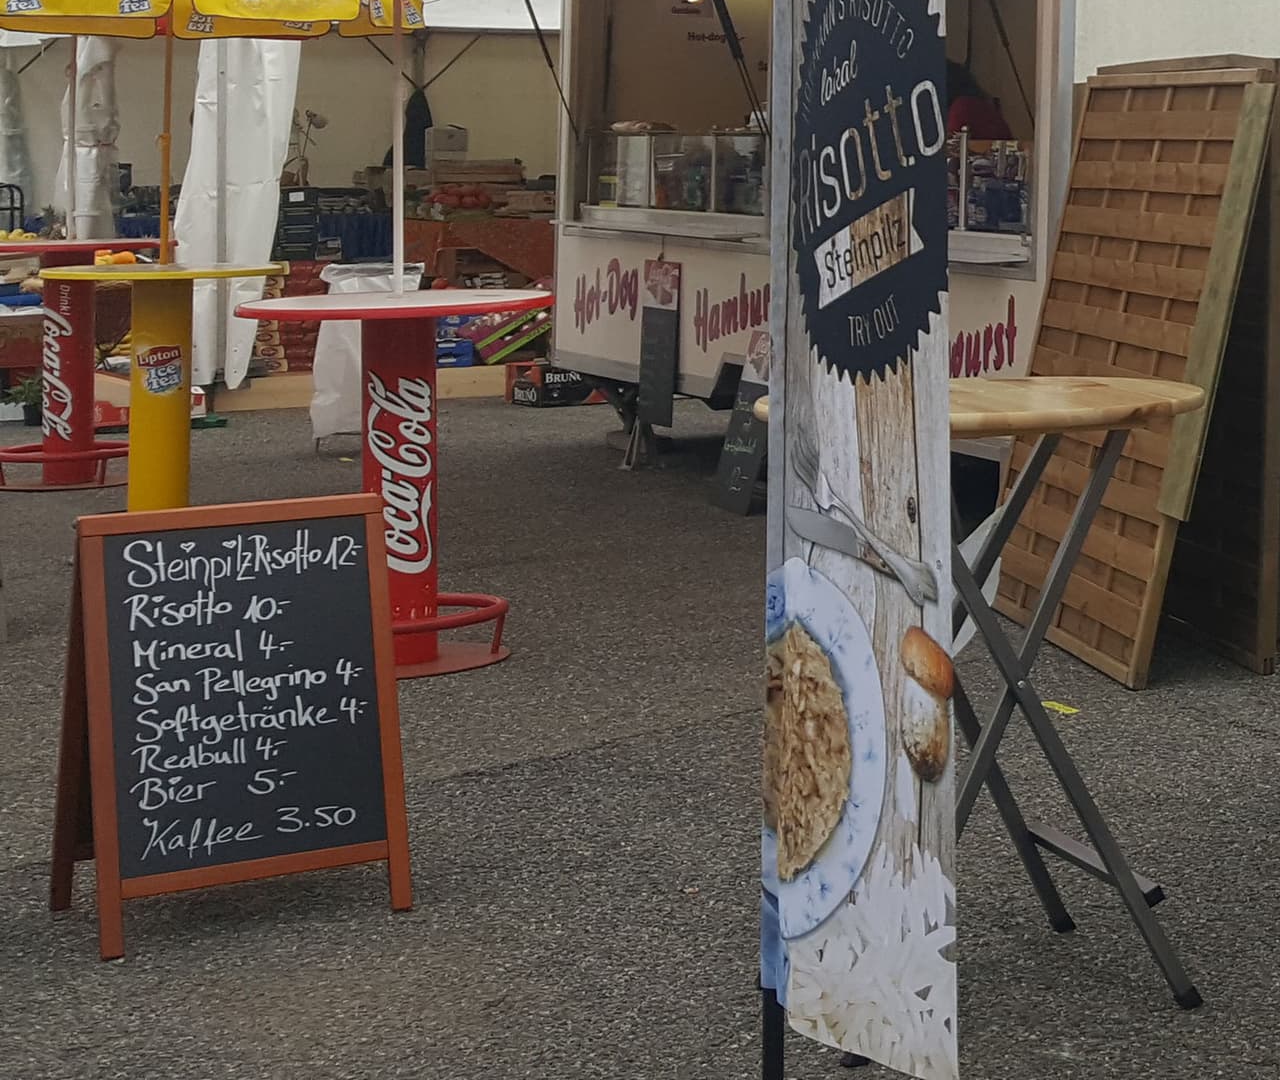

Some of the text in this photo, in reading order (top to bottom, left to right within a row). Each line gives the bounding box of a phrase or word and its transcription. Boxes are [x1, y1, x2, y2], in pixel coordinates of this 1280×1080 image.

[821, 39, 858, 107] lokal
[799, 79, 946, 246] Risotto
[825, 212, 909, 290] Steinpilz
[574, 258, 639, 336] Hot-Dog
[693, 273, 770, 353] Hambur
[848, 294, 901, 348] TRY OUT
[138, 348, 181, 365] Lipton
[147, 365, 177, 378] Ice
[147, 376, 183, 392] Tea
[124, 589, 232, 632] Risotto
[133, 629, 244, 671] Mineral
[133, 672, 191, 707] San
[195, 664, 327, 701] Pellegrino
[135, 695, 338, 745] Softgetränke
[130, 738, 247, 774] Redbull
[129, 775, 218, 811] Bier
[140, 806, 357, 861] Kaffee 3.50
